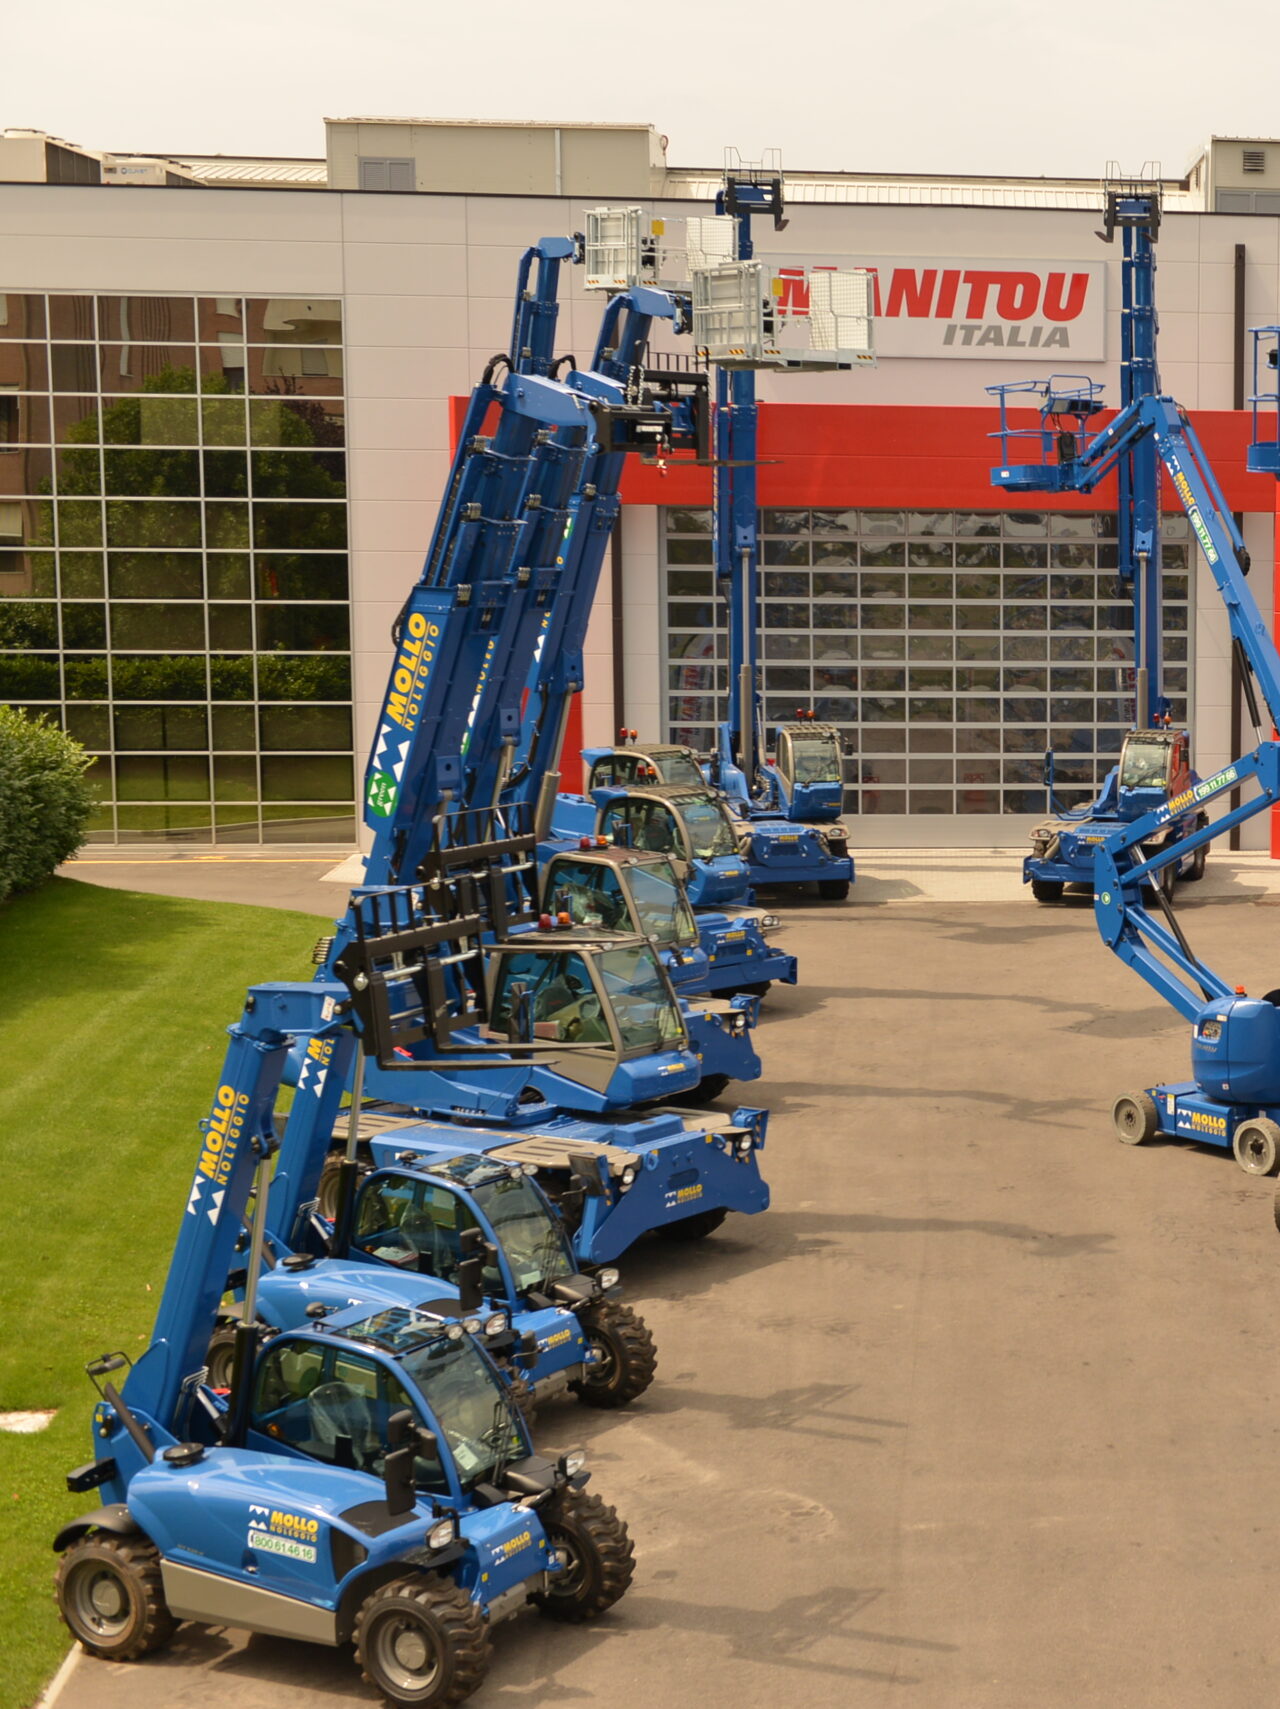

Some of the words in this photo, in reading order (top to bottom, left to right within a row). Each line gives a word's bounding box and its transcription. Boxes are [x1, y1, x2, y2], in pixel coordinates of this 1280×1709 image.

[778, 266, 1090, 322] MNITOU
[943, 324, 1070, 348] ITALIA
[1177, 471, 1195, 505] MOLLO
[386, 613, 427, 727] MOLLO
[403, 624, 439, 731] NOLEGGIO
[1168, 789, 1194, 810] MOLLO
[199, 1085, 235, 1180] MOLLO
[1192, 1112, 1226, 1129] MOLLO
[217, 1093, 250, 1186] NOLEGGIO
[271, 1510, 319, 1534] MOLLO
[503, 1531, 530, 1553] MOLLO
